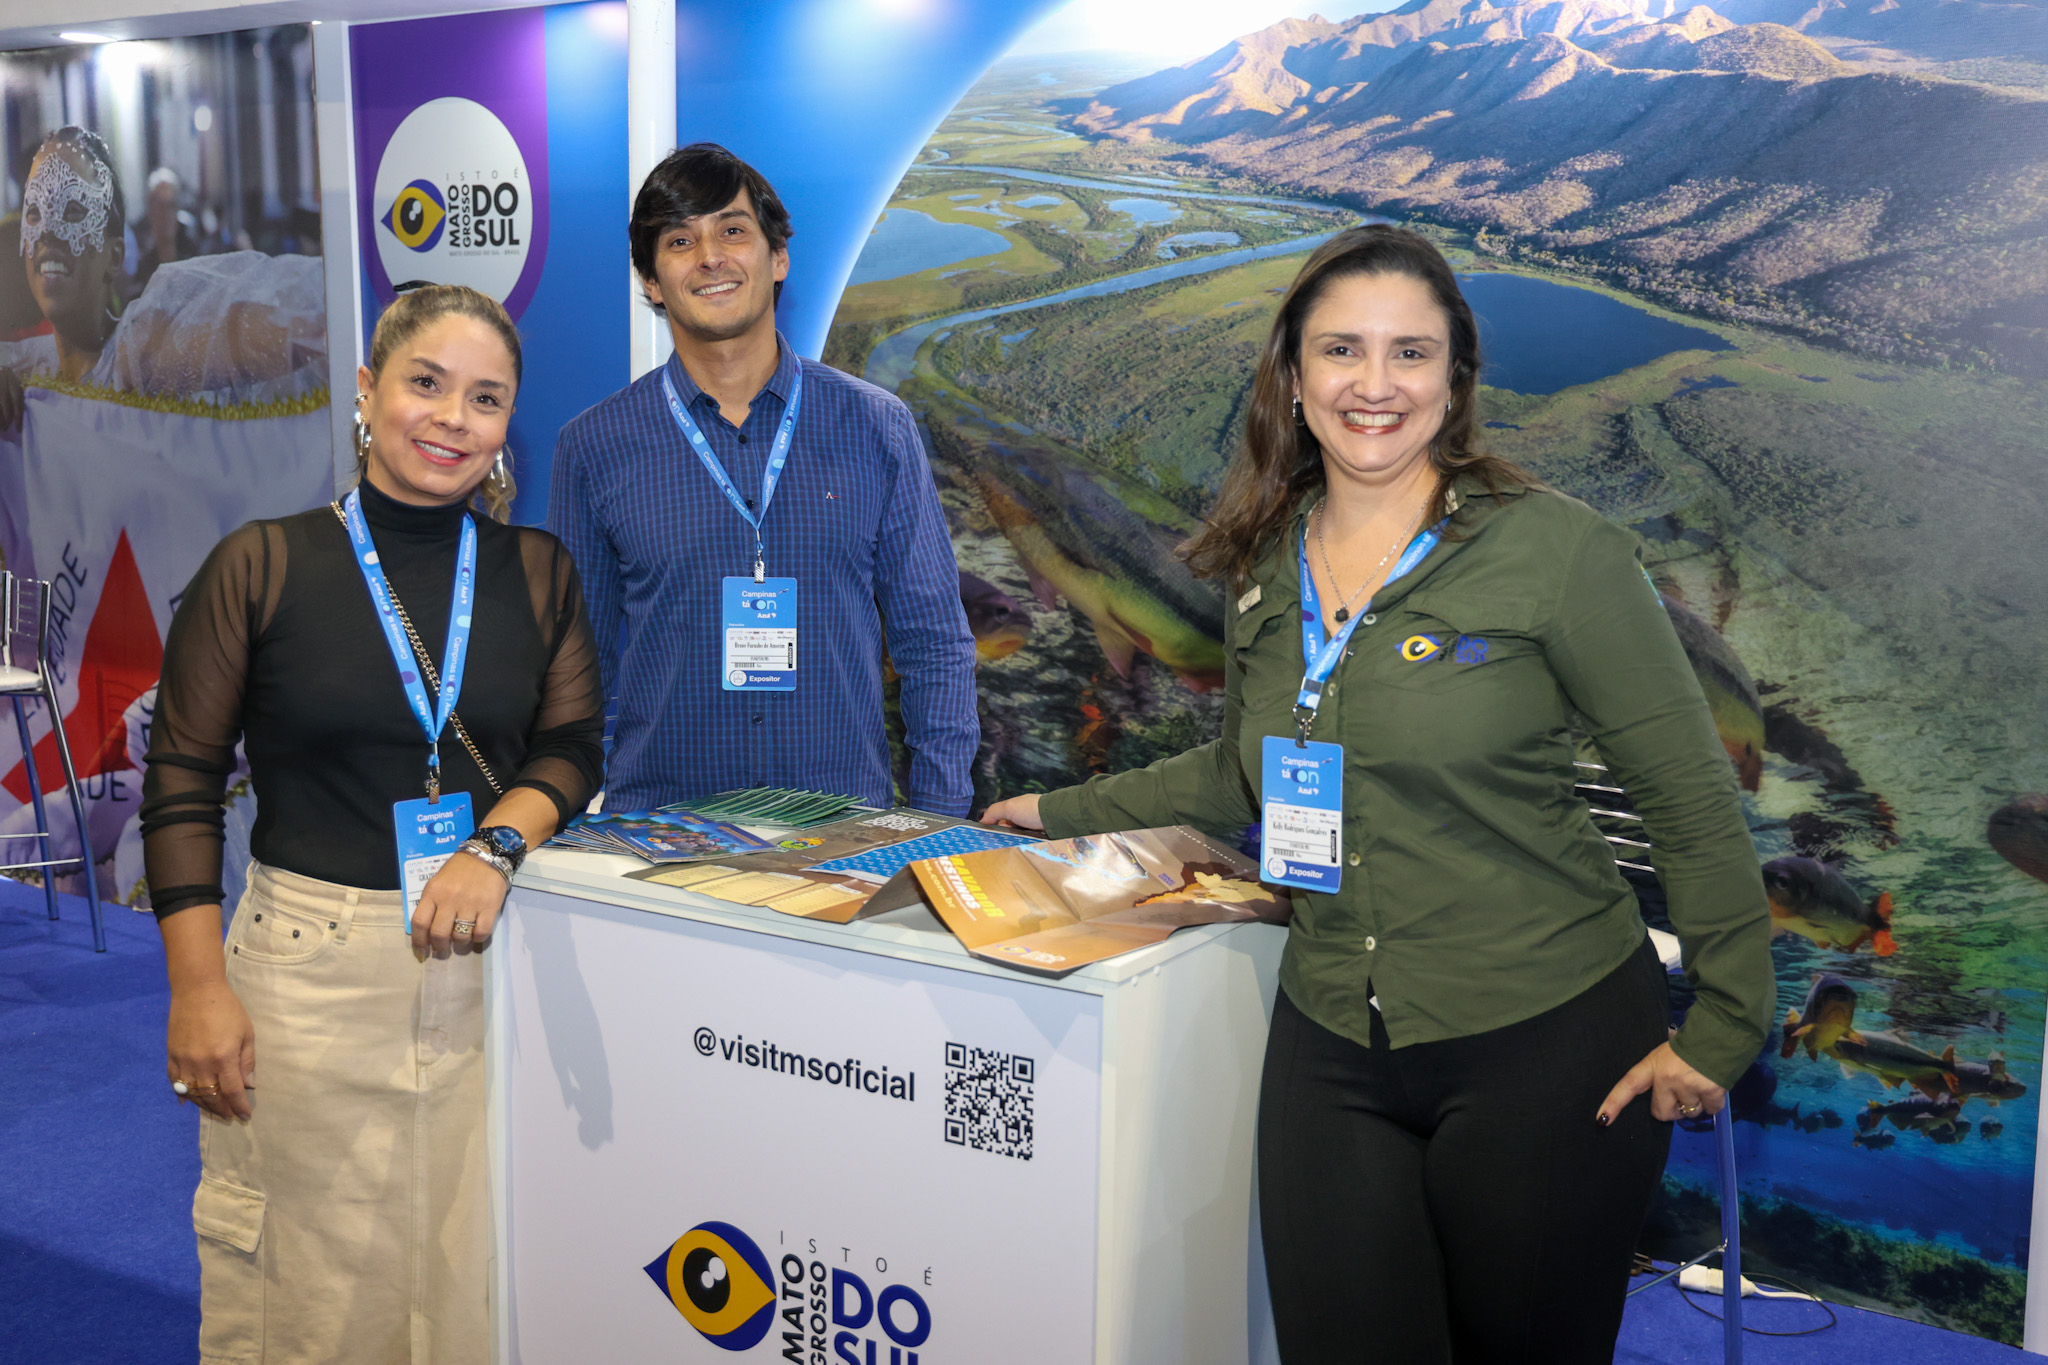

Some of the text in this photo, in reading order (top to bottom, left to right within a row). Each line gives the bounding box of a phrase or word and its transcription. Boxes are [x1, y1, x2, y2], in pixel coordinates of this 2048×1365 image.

[472, 182, 518, 216] DO
[448, 185, 460, 247] MATO
[462, 184, 471, 248] GROSSO
[474, 218, 520, 246] SUL
[703, 451, 722, 482] Campinas
[1396, 542, 1426, 577] Campinas
[742, 590, 776, 598] Campinas
[390, 623, 408, 660] Campinas
[450, 636, 462, 673] Campinas
[1457, 635, 1488, 653] DO
[1281, 756, 1319, 768] Campinas
[1281, 768, 1291, 778] tá
[1298, 786, 1312, 795] Azul
[417, 811, 453, 822] Campinas
[418, 825, 428, 834] tá
[949, 854, 1006, 918] RAVADOR
[1289, 866, 1324, 878] Expositor
[693, 1026, 915, 1101] @visitmsoficial
[781, 1253, 804, 1365] MATO
[832, 1267, 931, 1347] DO
